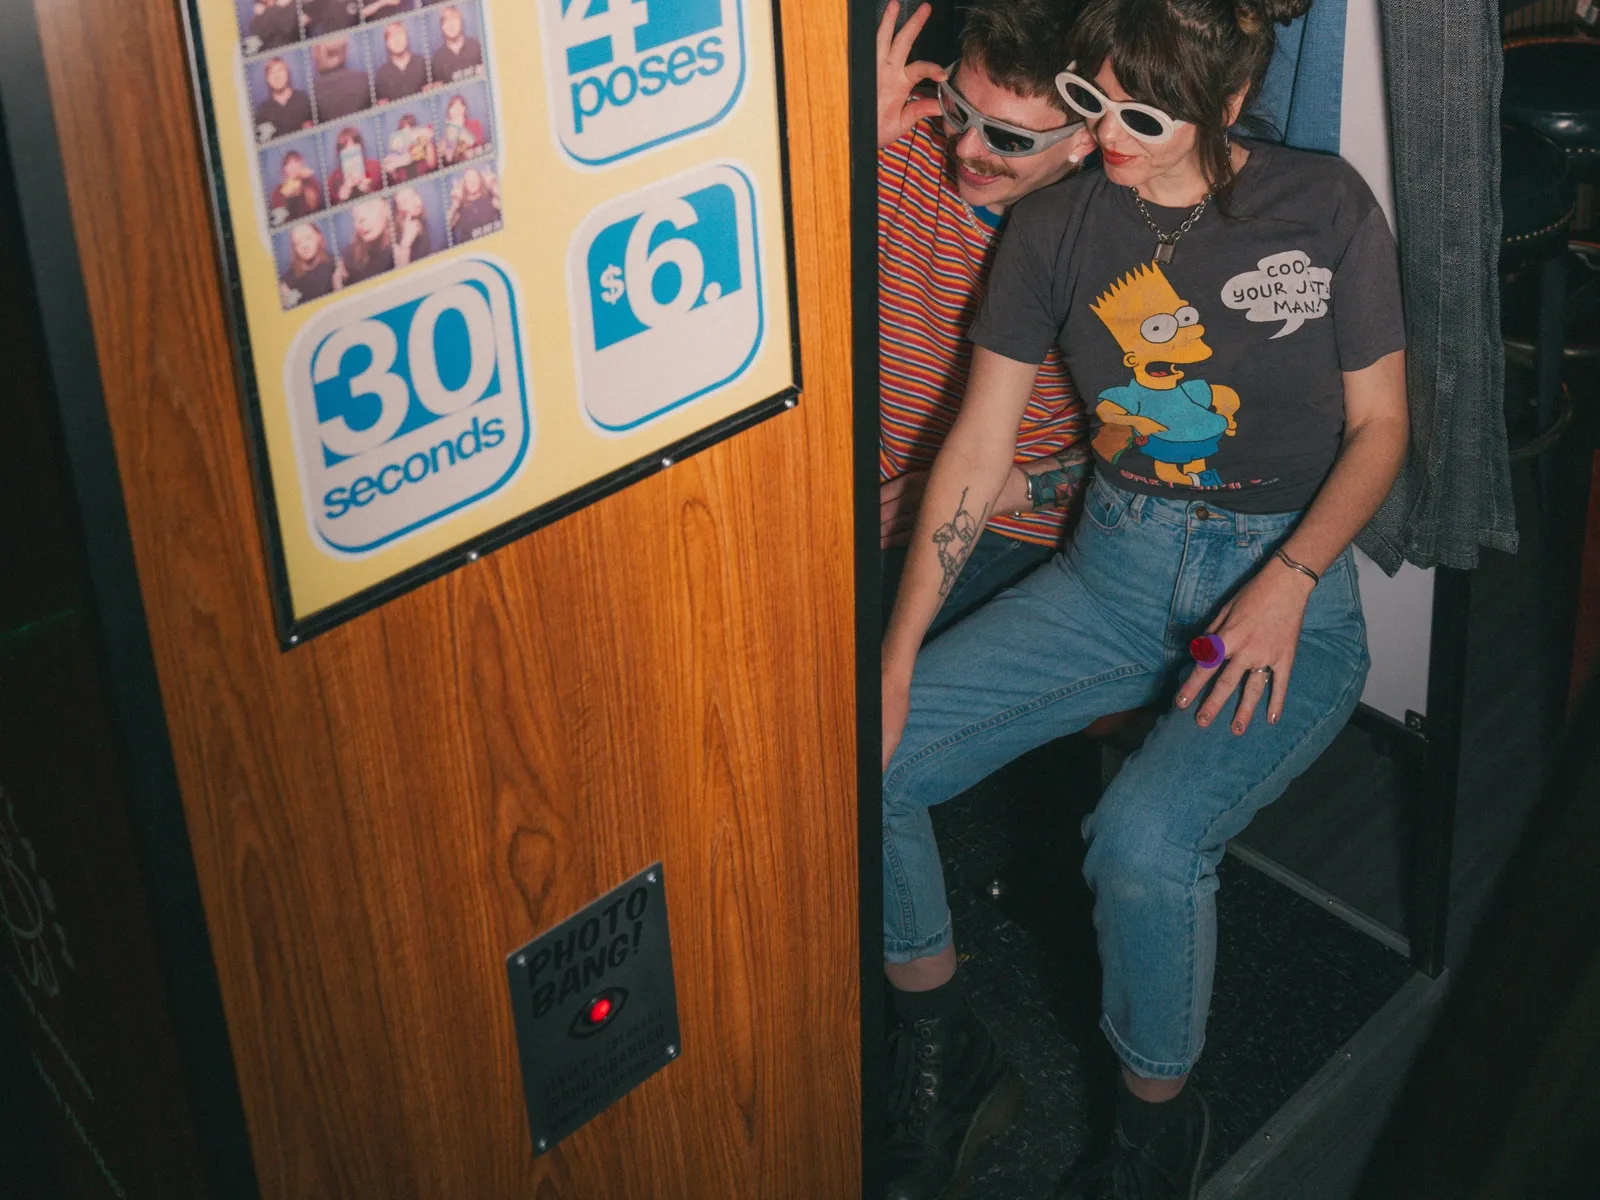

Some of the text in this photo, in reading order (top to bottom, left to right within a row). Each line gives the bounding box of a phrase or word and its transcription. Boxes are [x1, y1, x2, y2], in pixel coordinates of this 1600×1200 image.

[571, 36, 724, 134] poses
[1233, 282, 1288, 303] YOUR
[1267, 260, 1310, 277] COO
[1273, 299, 1322, 314] MAN!
[312, 282, 498, 457] 30
[323, 417, 506, 519] seconds
[527, 886, 649, 988] PHOTO
[532, 921, 643, 1018] BANG!
